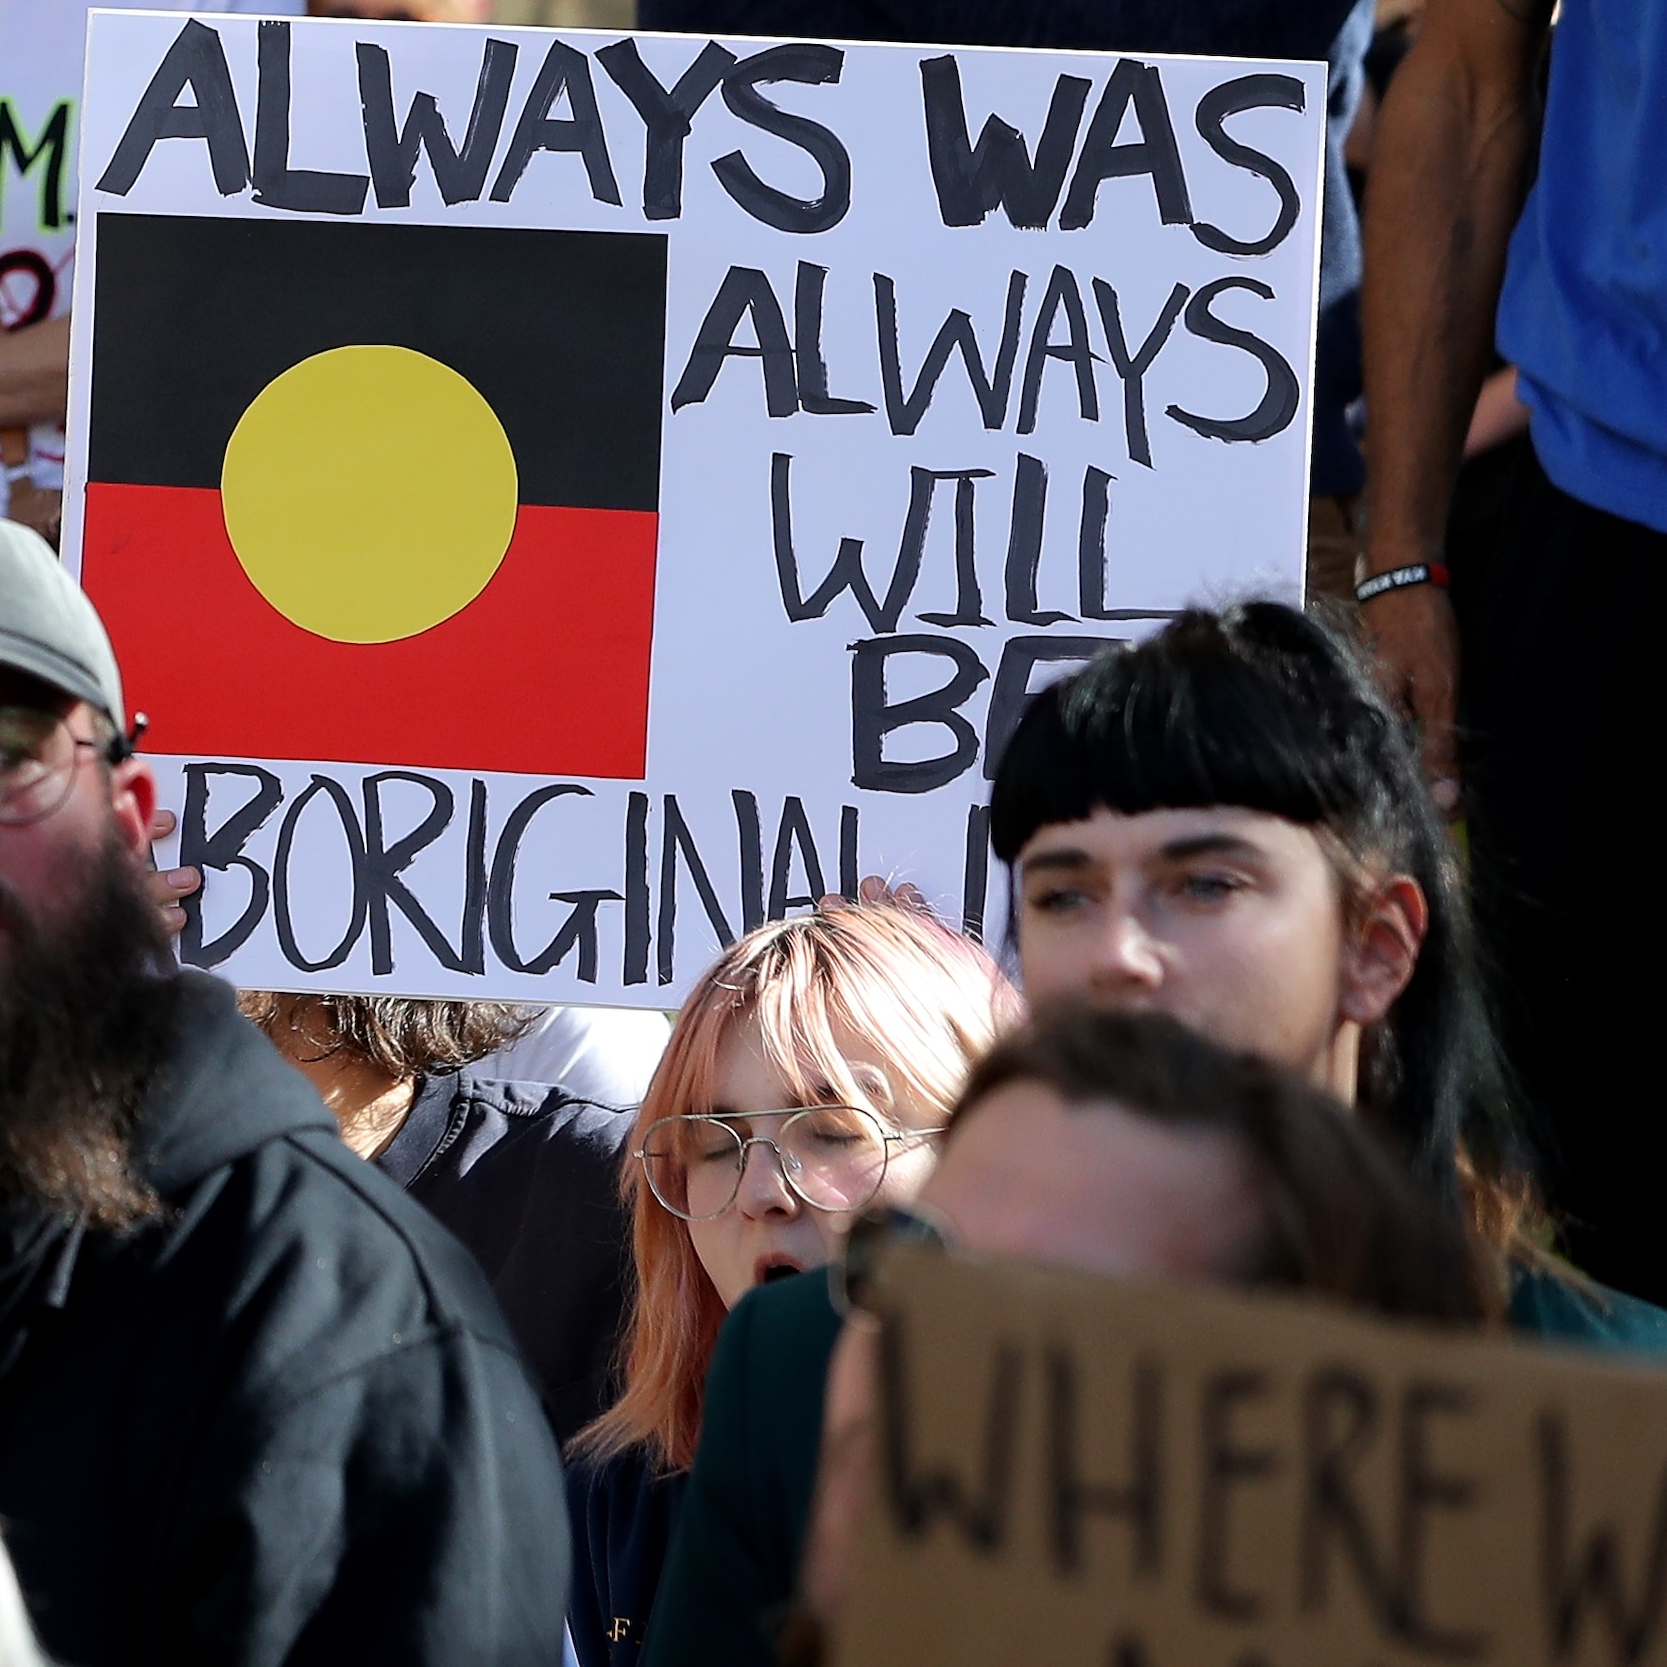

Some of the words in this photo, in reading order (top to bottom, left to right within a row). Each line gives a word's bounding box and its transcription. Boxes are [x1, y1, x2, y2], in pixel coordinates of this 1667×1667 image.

[95, 19, 852, 234] ALWAYS
[920, 53, 1307, 257] WAS
[670, 260, 1300, 468] ALWAYS
[771, 451, 1179, 634] WILL
[875, 1314, 1489, 1660] WHERE
